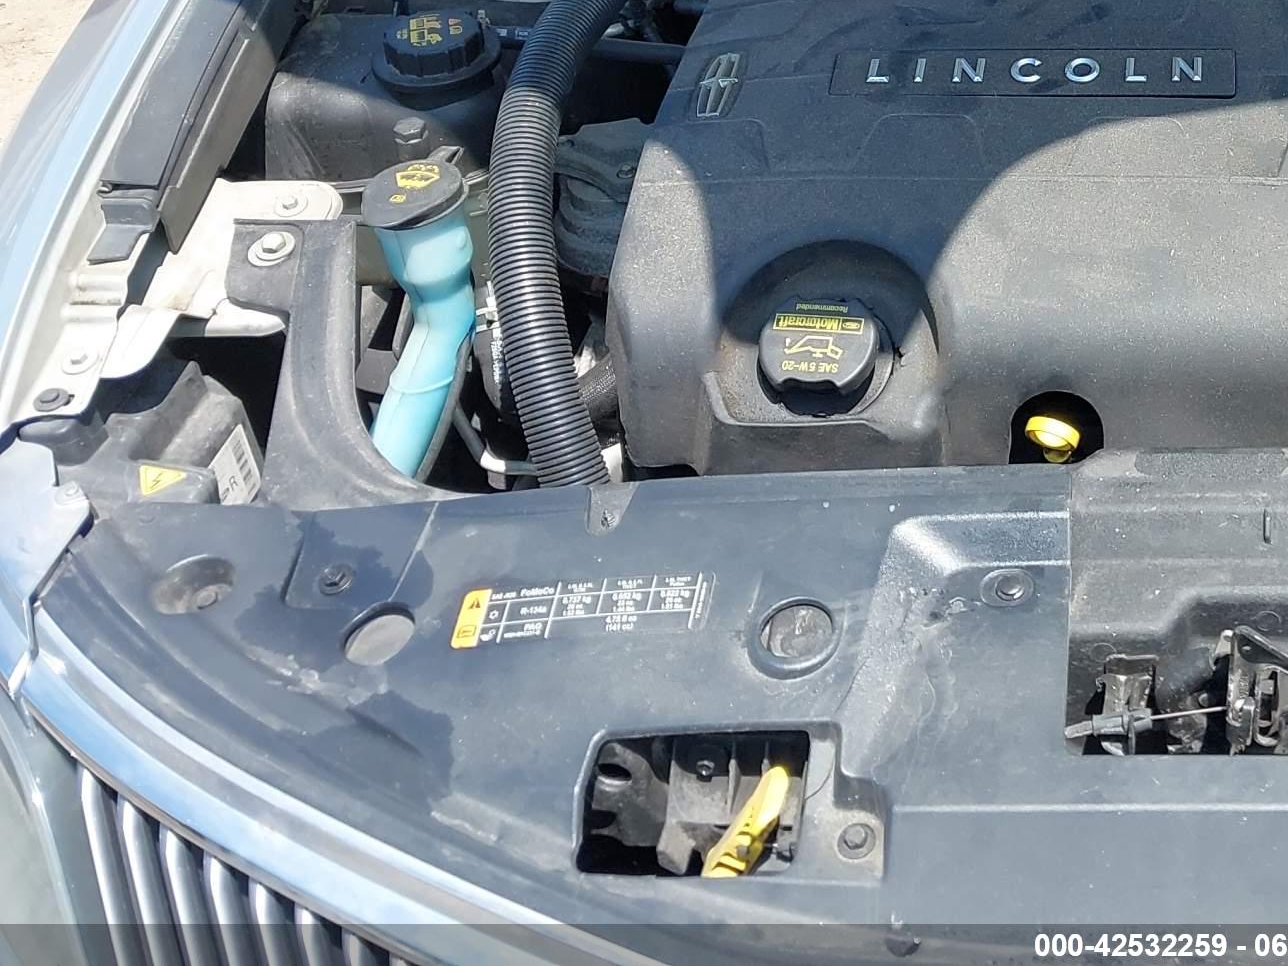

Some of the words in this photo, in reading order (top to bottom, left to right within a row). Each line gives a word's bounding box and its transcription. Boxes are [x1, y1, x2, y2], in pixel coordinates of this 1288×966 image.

[865, 57, 1203, 83] LINCOLN
[796, 303, 849, 313] Recommended
[778, 315, 840, 331] Motorcraft
[817, 362, 839, 373] SAE
